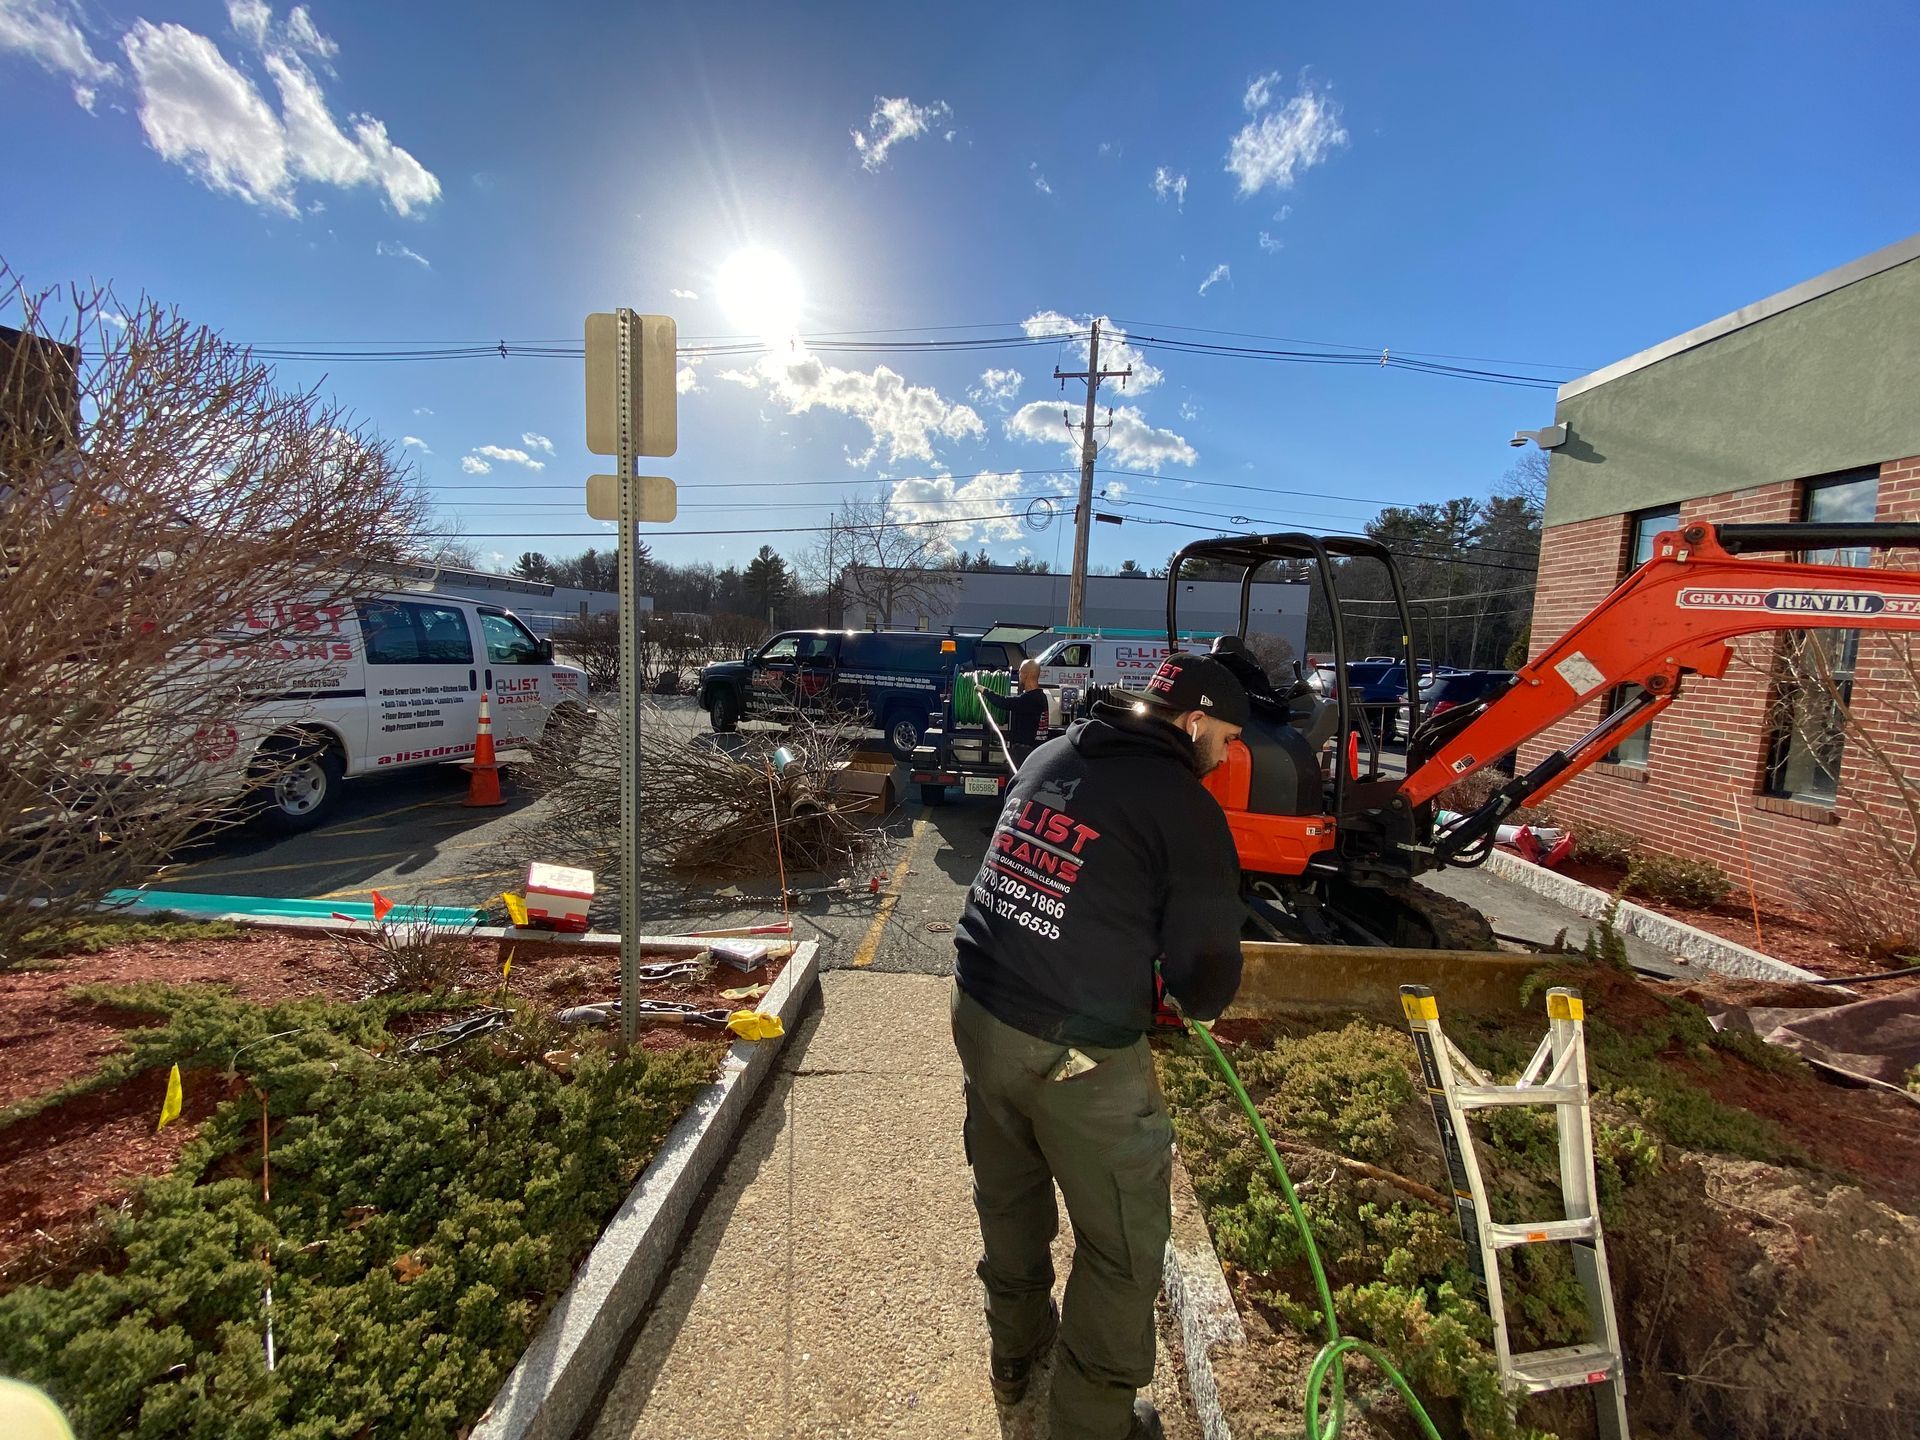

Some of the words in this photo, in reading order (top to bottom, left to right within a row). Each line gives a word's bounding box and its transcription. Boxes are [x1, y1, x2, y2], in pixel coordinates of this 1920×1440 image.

[240, 602, 345, 633] LIST
[1689, 593, 1761, 605] GRAND
[1775, 593, 1872, 612] RENTAL
[496, 678, 539, 695] A-LIST
[1000, 856, 1024, 872] QUALITY
[1024, 867, 1039, 880] DRAIN
[1038, 875, 1071, 894] CLEANING
[998, 875, 1066, 919] 209-1866
[996, 898, 1060, 940] 327-6535
